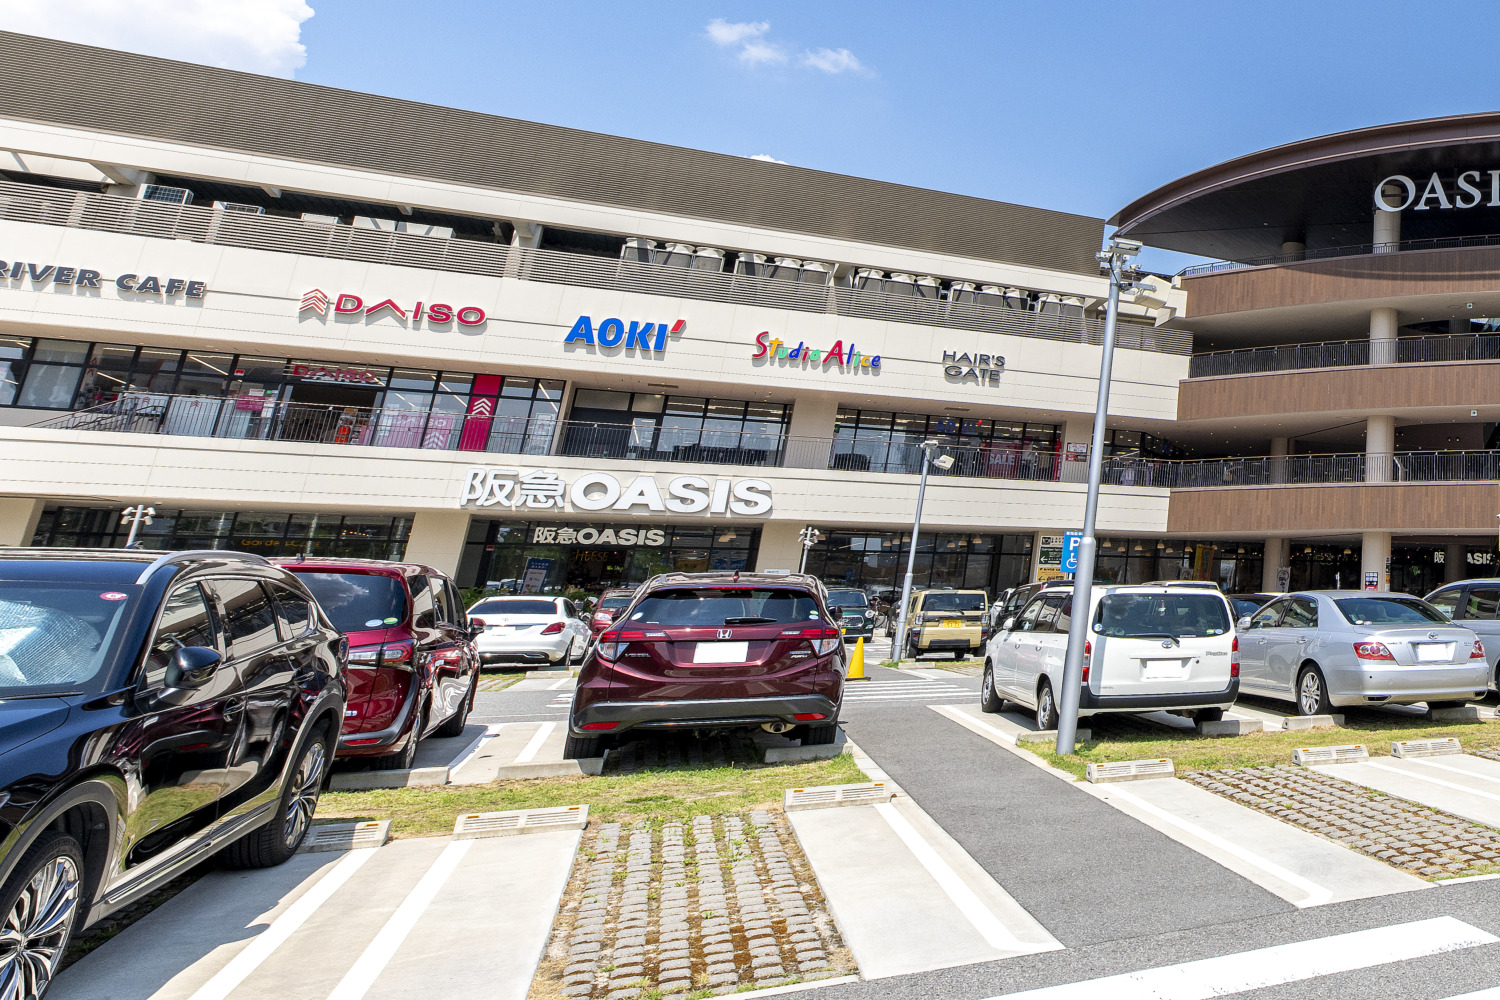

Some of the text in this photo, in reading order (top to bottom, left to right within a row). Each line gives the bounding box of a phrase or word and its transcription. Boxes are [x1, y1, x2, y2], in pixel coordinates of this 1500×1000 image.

[115, 273, 206, 298] CAFE
[334, 293, 487, 326] DAISO
[563, 315, 671, 351] AOKI
[752, 331, 881, 367] Studio Alice
[942, 350, 1005, 367] HAIR'S
[293, 365, 376, 382] DAISO
[944, 365, 1000, 381] GATE
[460, 468, 773, 515] 阪急OASIS
[533, 527, 665, 545] 阪急OASIS
[1069, 537, 1081, 551] P
